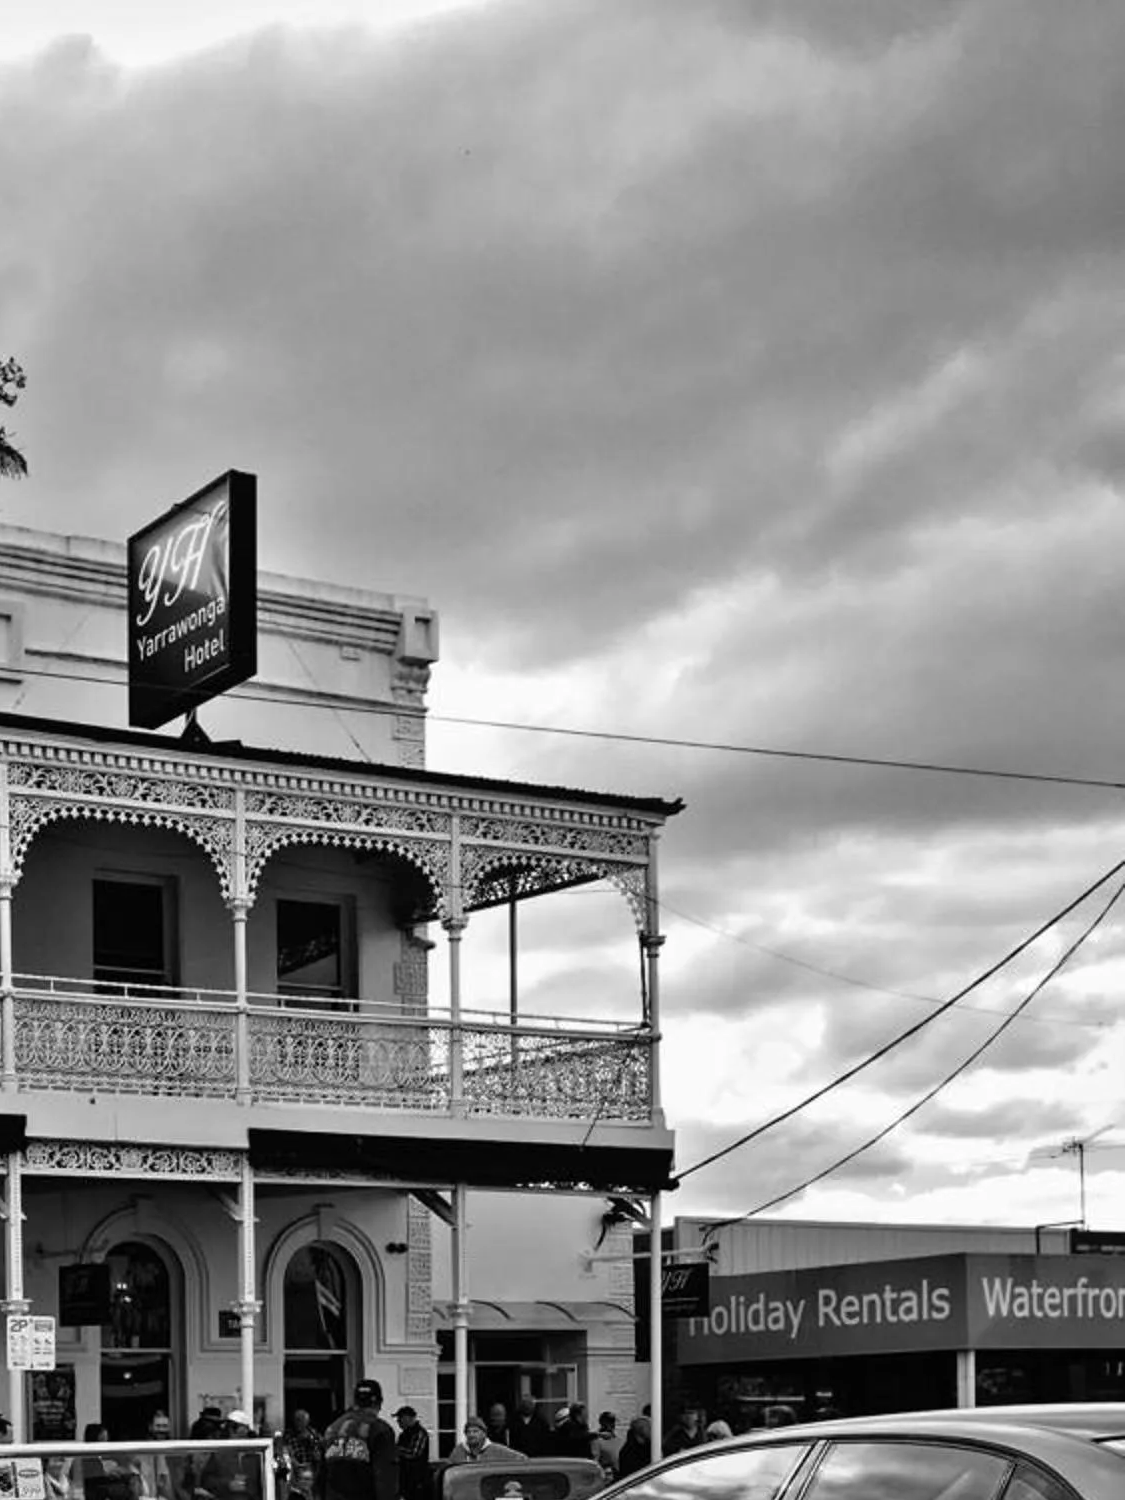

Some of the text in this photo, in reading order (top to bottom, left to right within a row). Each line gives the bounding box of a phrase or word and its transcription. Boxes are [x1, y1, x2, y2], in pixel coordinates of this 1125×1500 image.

[137, 596, 226, 661] Yarrawonga
[184, 629, 225, 672] Hotel
[818, 1279, 951, 1327] Rentals
